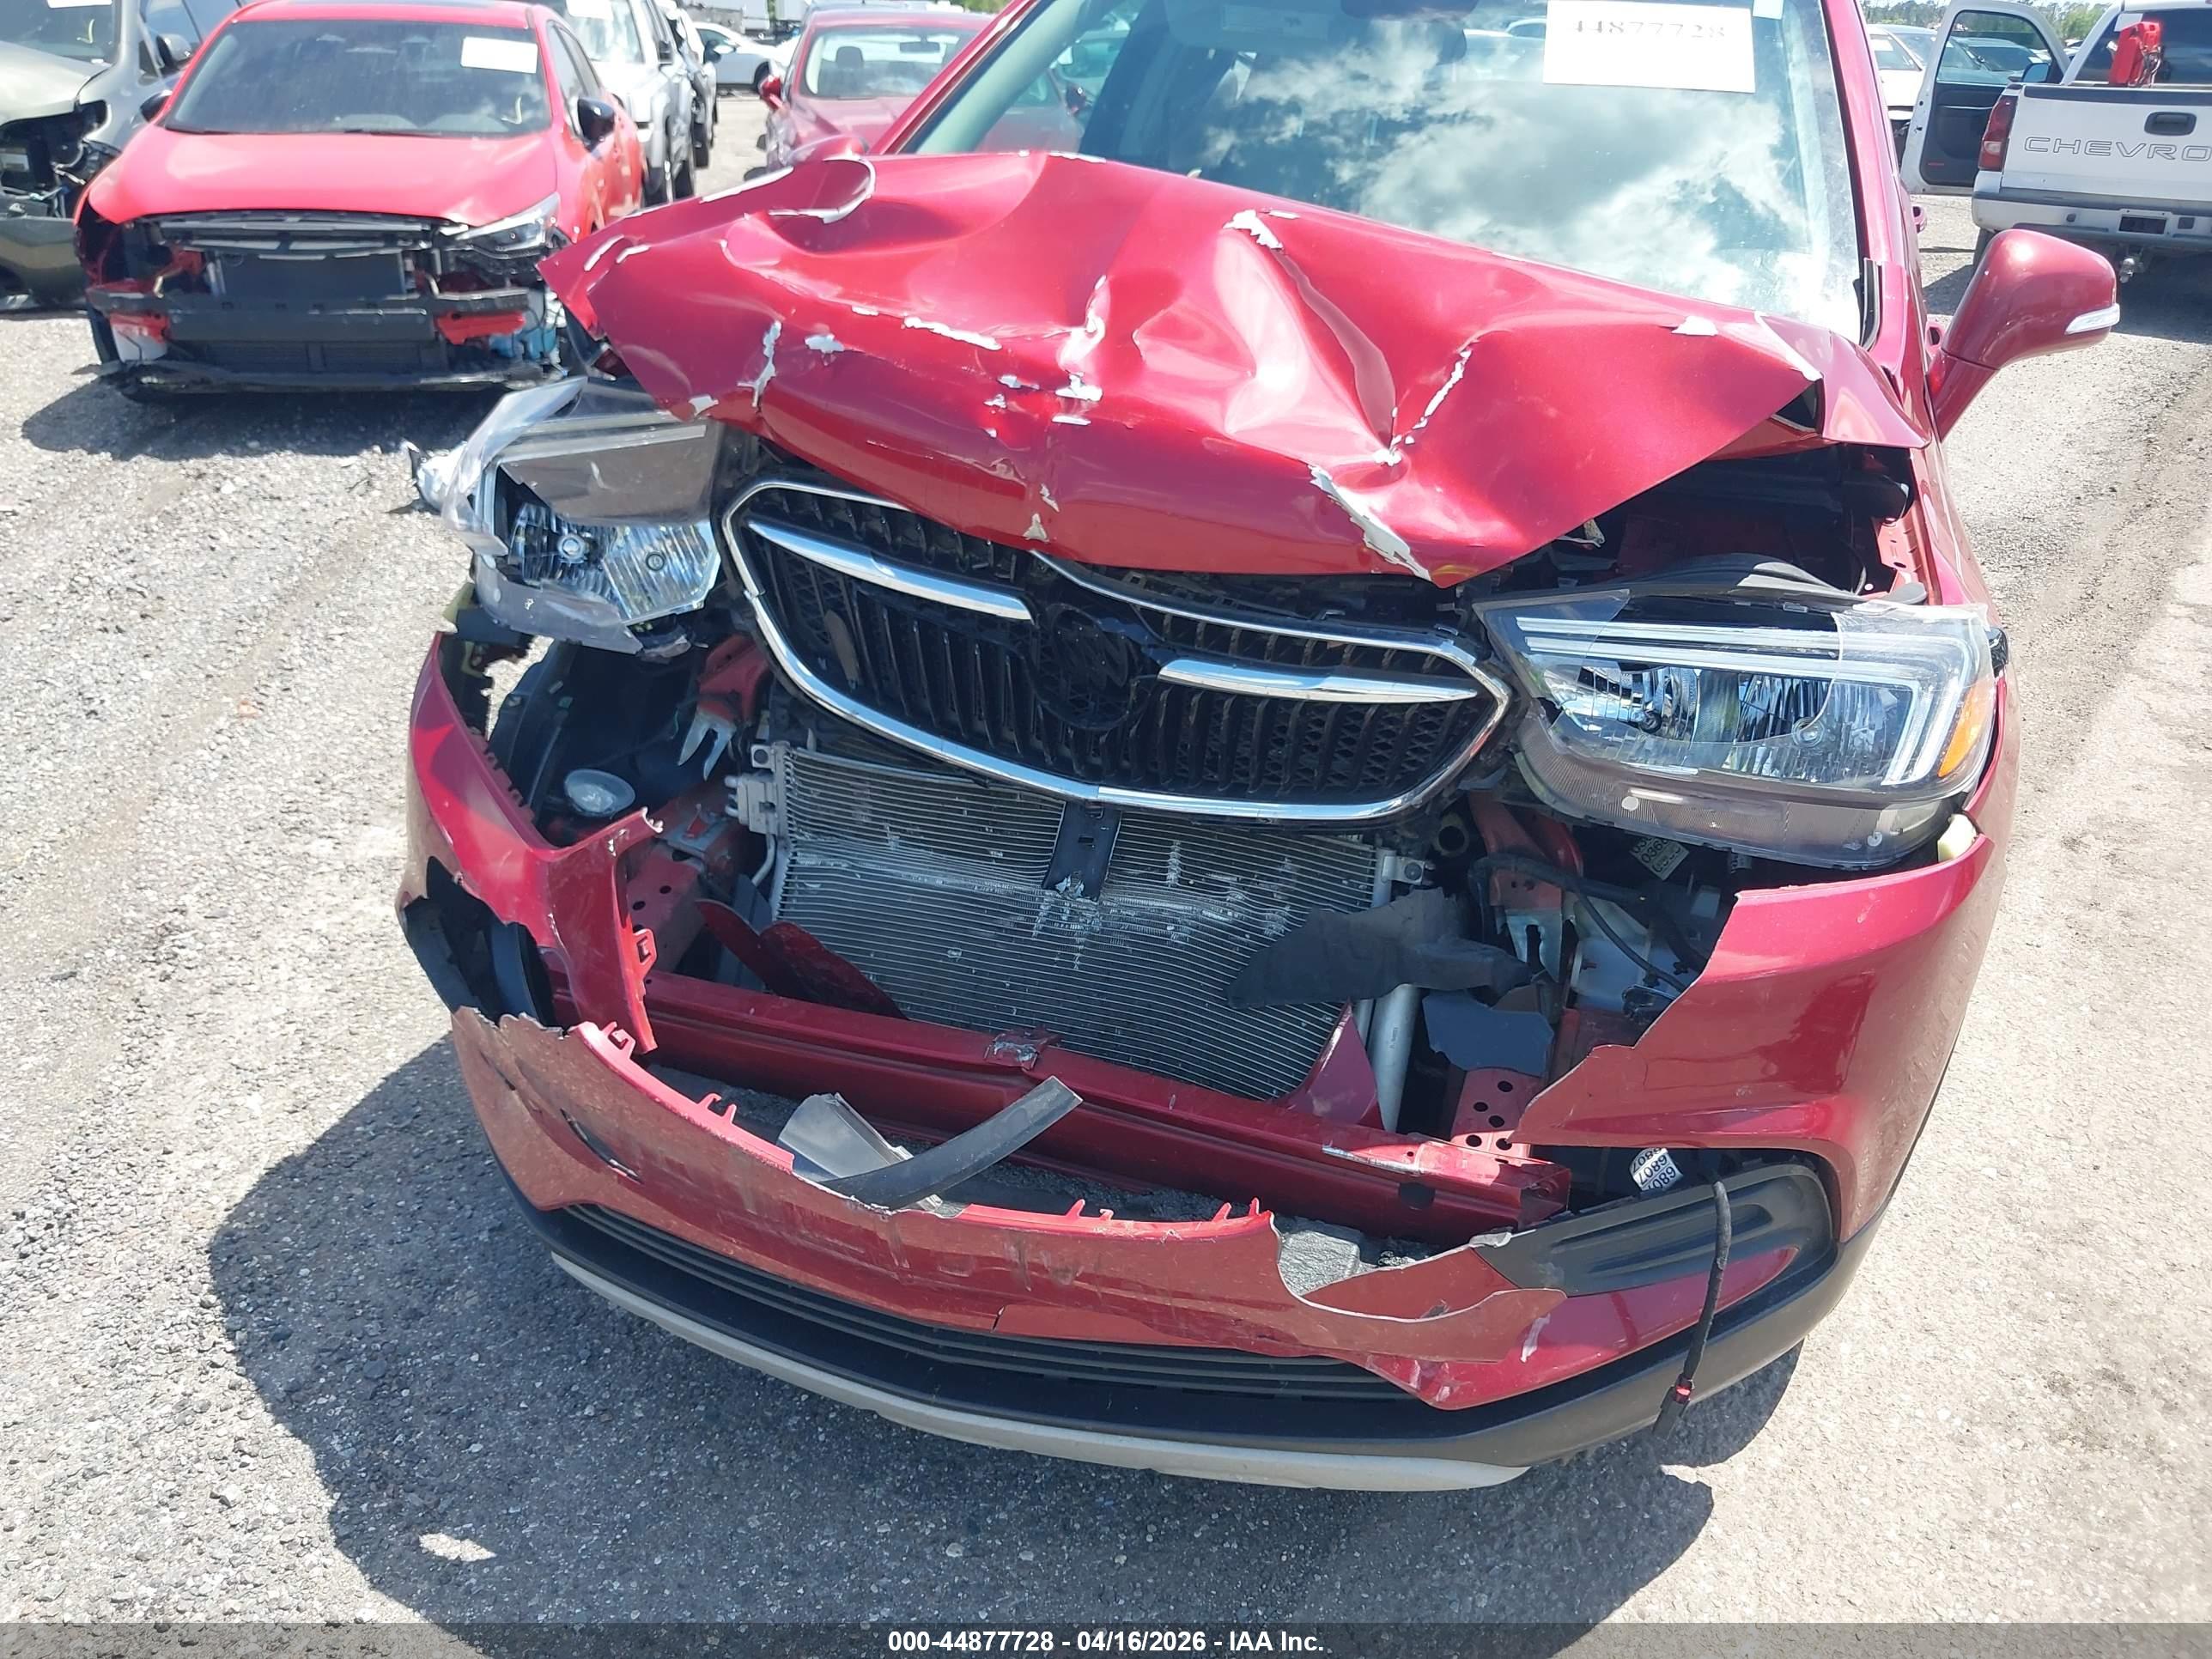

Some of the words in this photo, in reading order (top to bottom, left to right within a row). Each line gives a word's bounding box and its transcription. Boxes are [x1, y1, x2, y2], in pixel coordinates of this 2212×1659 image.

[2024, 136, 2212, 162] CHEVRO
[1638, 1154, 1668, 1186] 6807
[1648, 1166, 1677, 1189] 680
